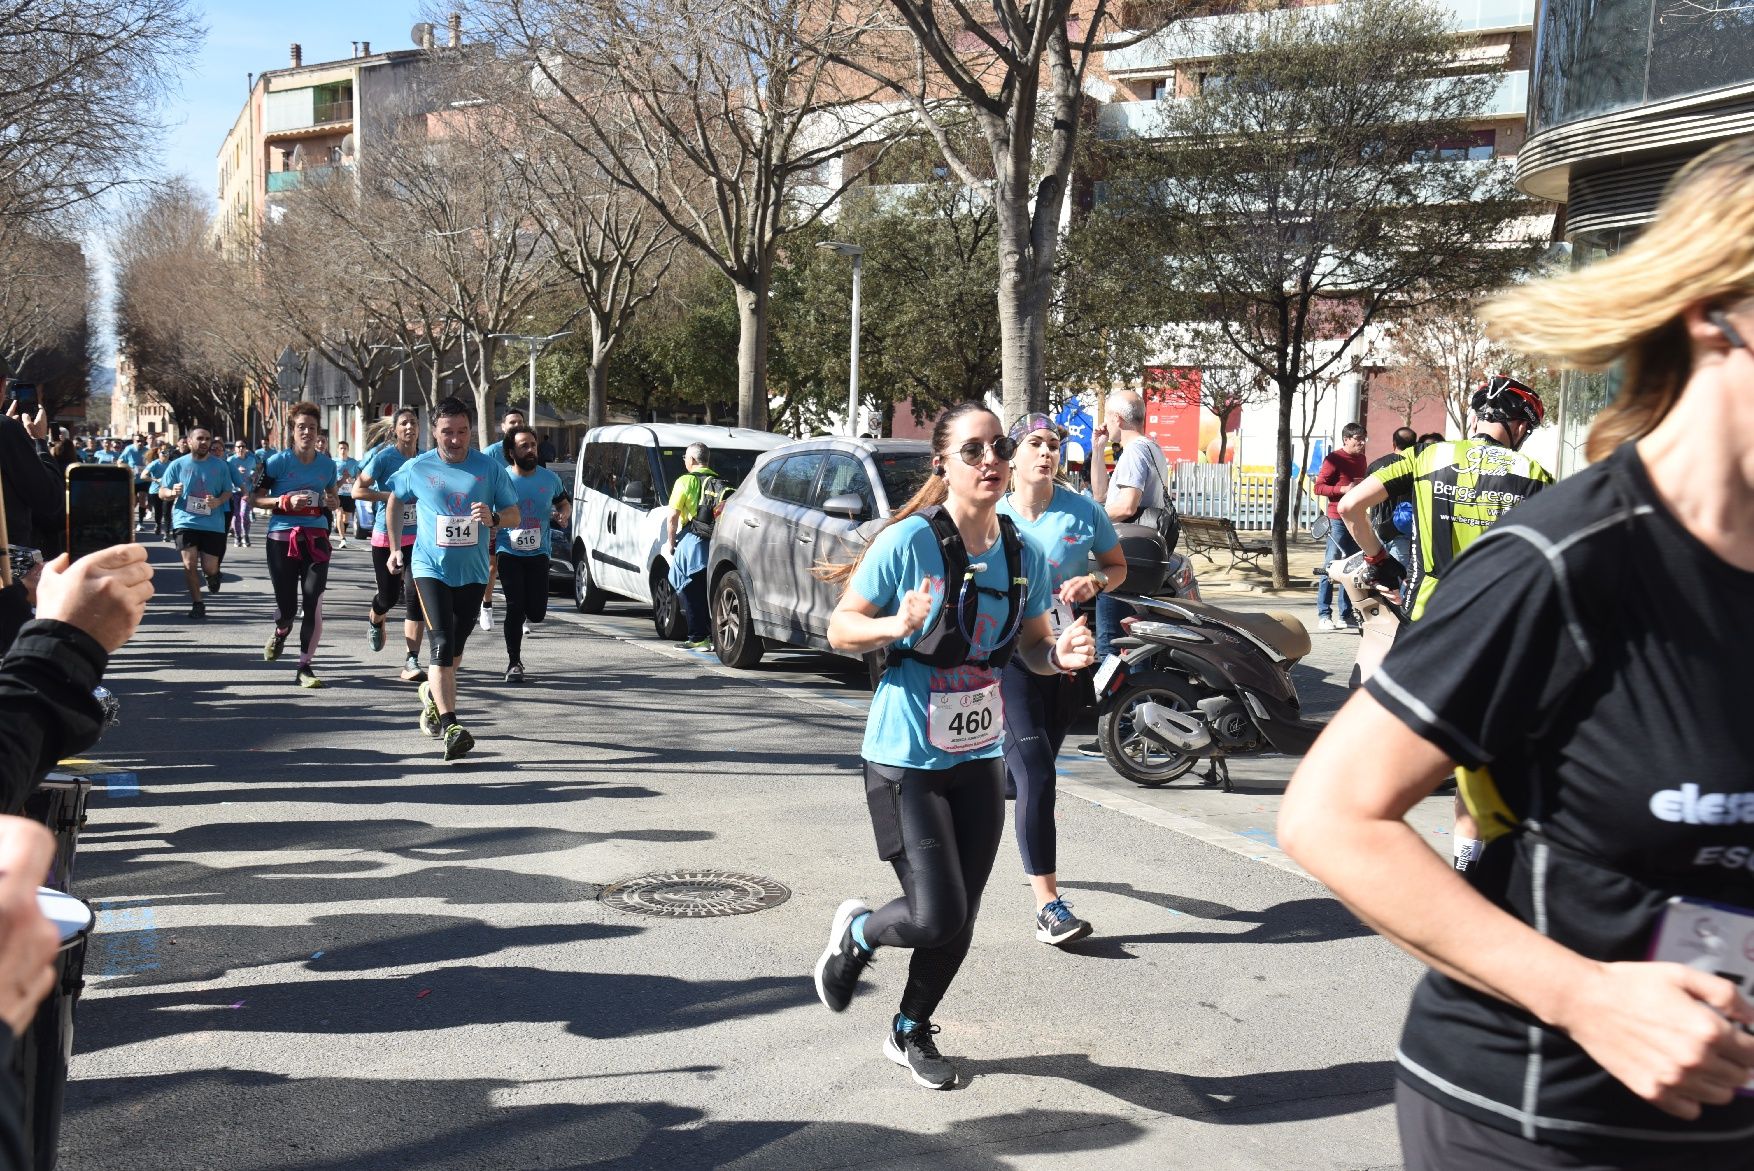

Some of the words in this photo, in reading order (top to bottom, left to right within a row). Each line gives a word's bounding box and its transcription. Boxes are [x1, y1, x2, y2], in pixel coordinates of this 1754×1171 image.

[1434, 481, 1476, 501] Berga
[404, 511, 418, 520] 51
[445, 526, 471, 538] 514
[517, 535, 536, 546] 516
[949, 706, 992, 735] 460
